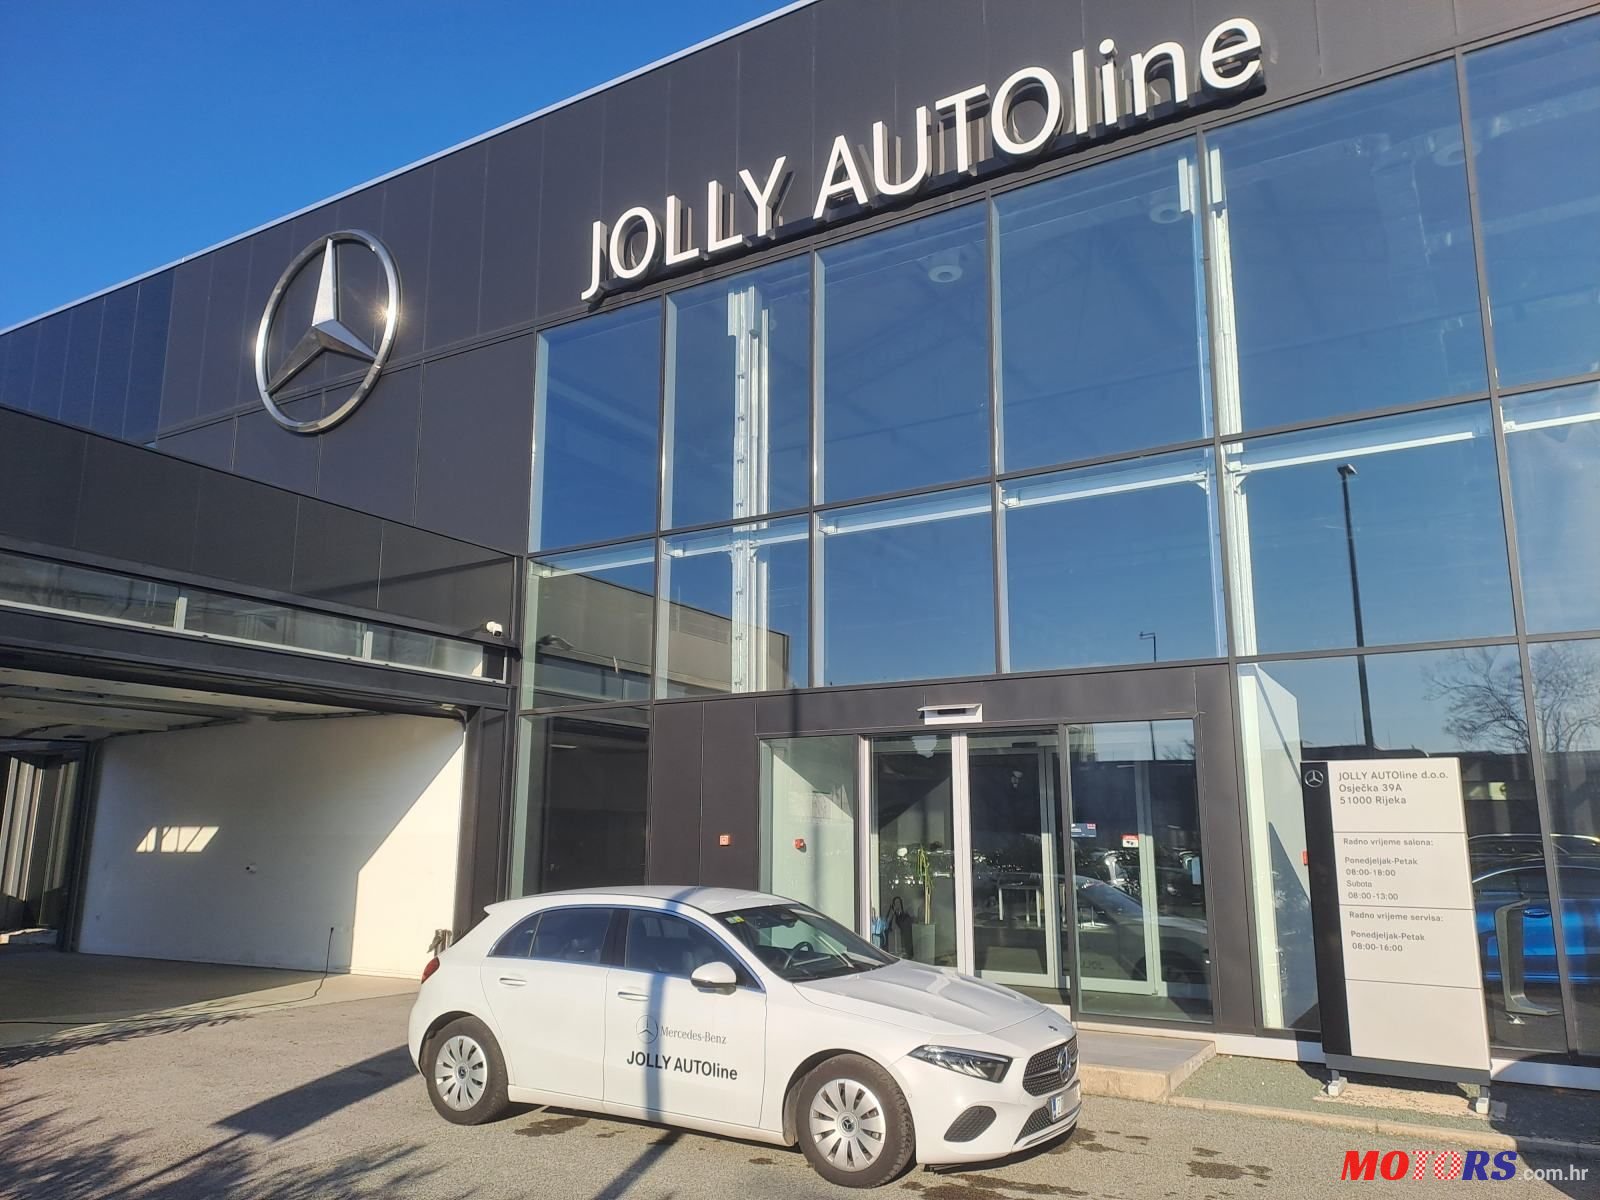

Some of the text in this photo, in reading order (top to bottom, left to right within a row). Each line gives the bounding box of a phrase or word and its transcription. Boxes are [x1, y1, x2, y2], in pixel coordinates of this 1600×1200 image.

[582, 18, 1262, 300] JOLLY AUTOline
[1339, 770, 1448, 781] JOLLY AUTOline d.o.o.
[1339, 783, 1402, 793] Osječka 39A
[1340, 796, 1407, 806] 51000 Rijeka
[1343, 838, 1434, 847] Radno vrijeme salona:
[1344, 856, 1418, 866] Ponedjeljak-Petak
[1345, 868, 1396, 877] 08:00-18:00
[1346, 880, 1373, 888] Subota
[1349, 911, 1444, 922] Radno vrijeme servisa:
[1351, 931, 1425, 941] Ponedjeljak-Petak
[1352, 942, 1403, 952] 08:00-16:00
[660, 1026, 727, 1045] Mercedes-Benz
[627, 1051, 737, 1080] JOLLY AUTOline
